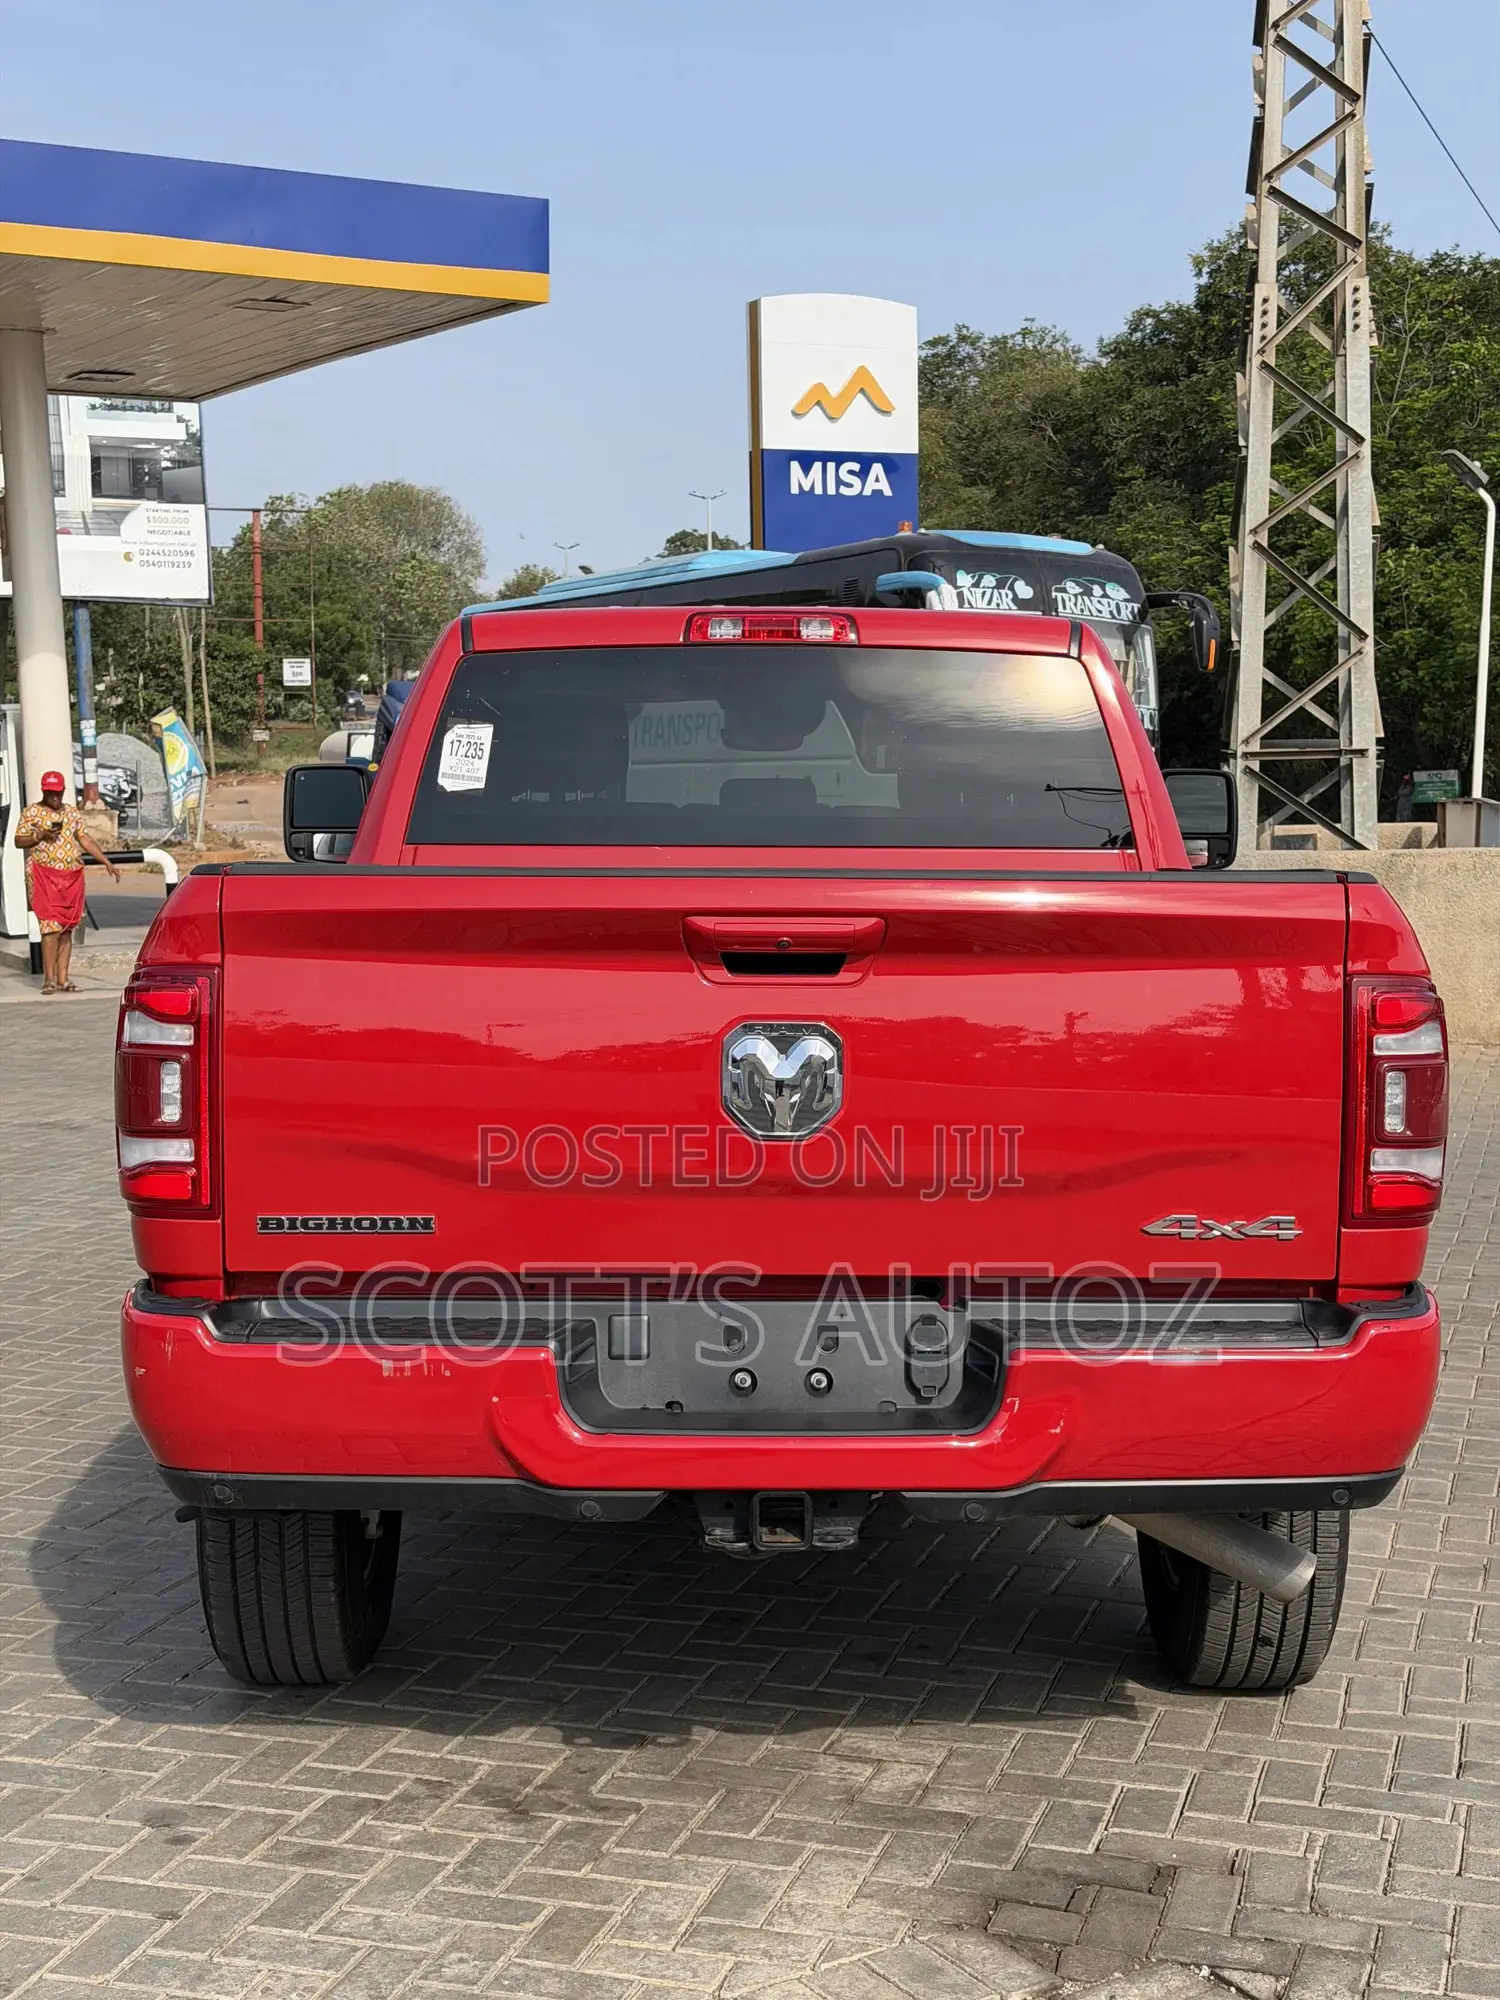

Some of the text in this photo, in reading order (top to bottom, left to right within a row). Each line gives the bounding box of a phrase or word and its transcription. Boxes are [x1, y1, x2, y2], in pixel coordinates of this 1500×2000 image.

[789, 461, 893, 497] MISA
[147, 529, 191, 537] NEGOTIABLE
[139, 548, 196, 558] 0244520596
[963, 587, 1141, 622] NIZAR TRANSPORT
[449, 738, 485, 760] 17:235
[455, 758, 475, 767] 2024
[747, 1023, 820, 1035] RAM
